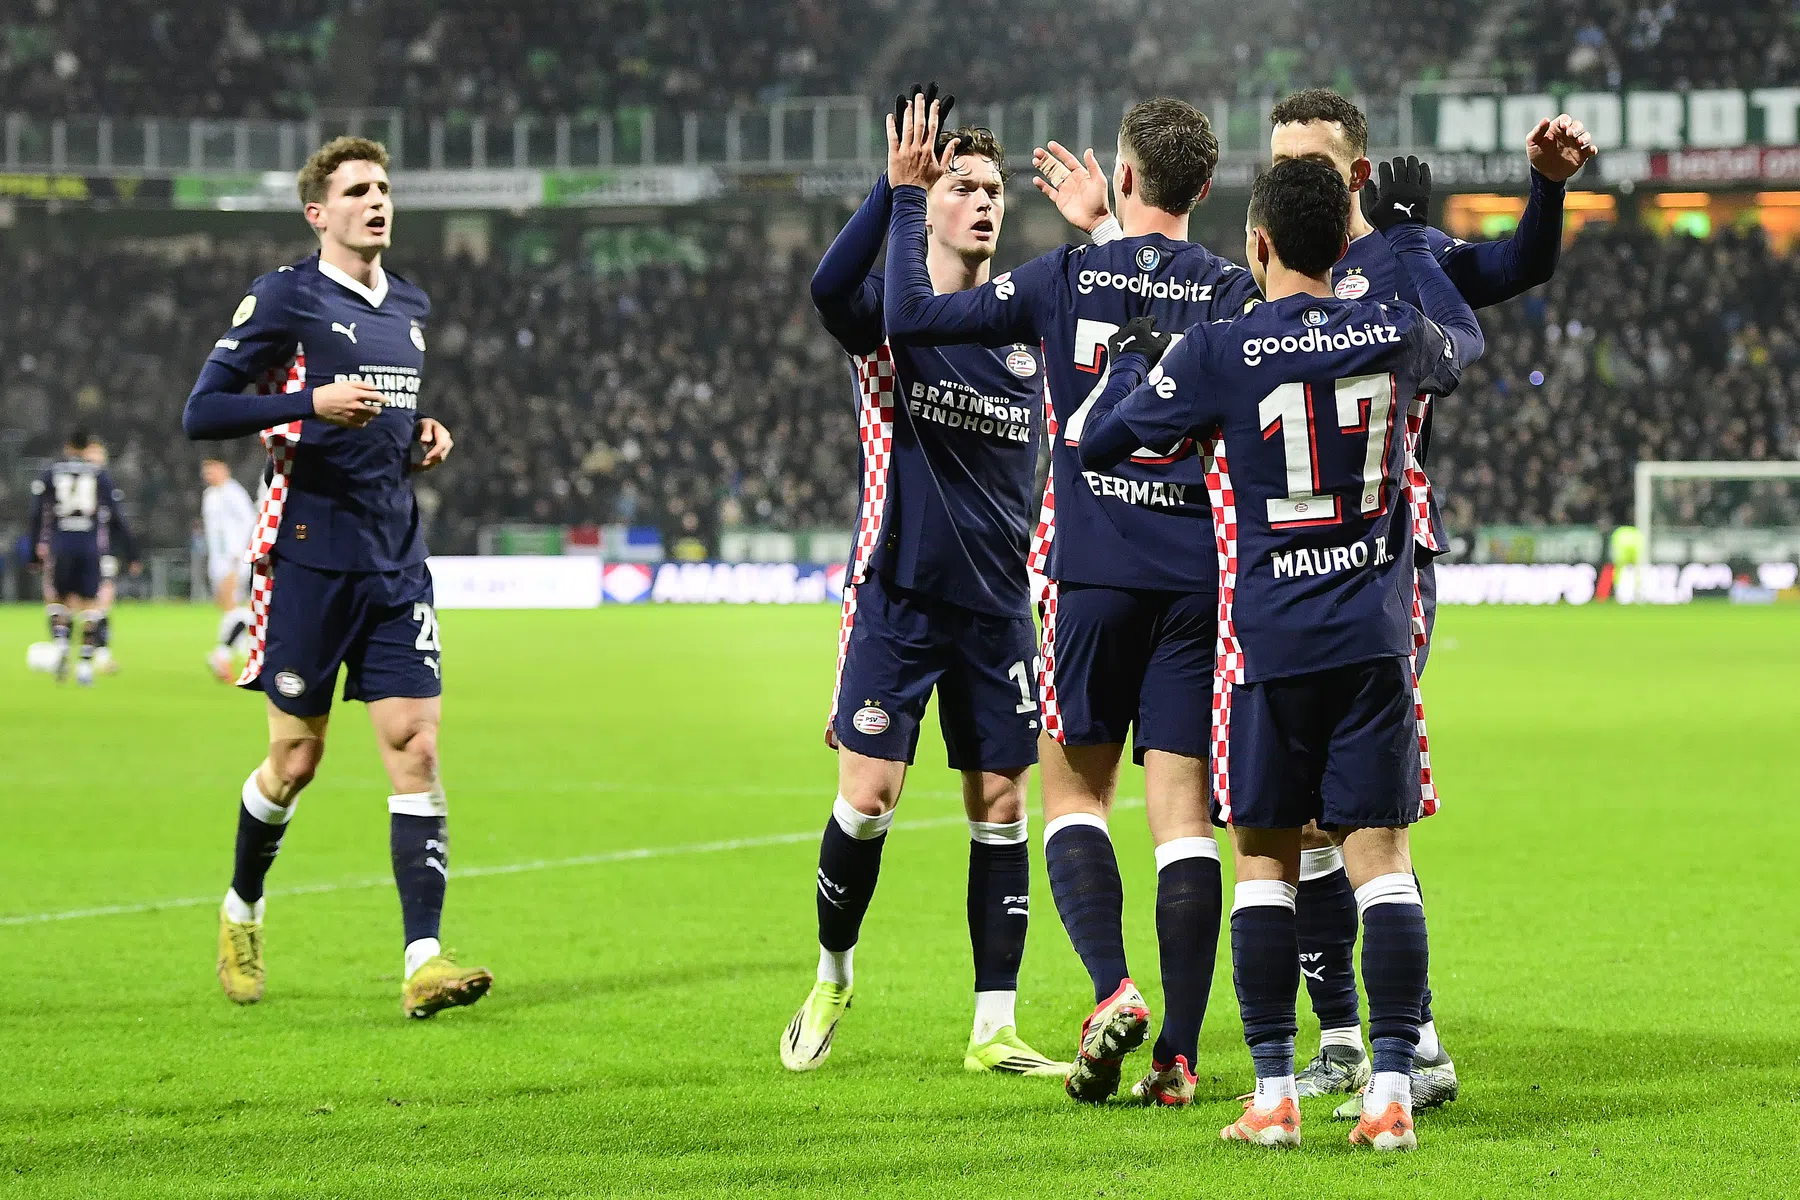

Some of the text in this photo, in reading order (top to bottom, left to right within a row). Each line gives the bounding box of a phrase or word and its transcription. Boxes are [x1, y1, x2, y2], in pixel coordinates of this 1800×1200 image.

[1077, 270, 1213, 303] goodhabitz
[1243, 323, 1401, 366] goodhabitz
[911, 381, 1031, 425] BRAINPORT
[939, 379, 1010, 404] METROPREGIO
[1064, 318, 1193, 465] 2
[909, 400, 1030, 443] EINDHOVEN
[1258, 372, 1396, 529] 17
[1081, 471, 1186, 507] EERMAN
[1271, 536, 1395, 579] MAURO JR.
[1002, 895, 1029, 905] PS
[1299, 952, 1324, 962] SV
